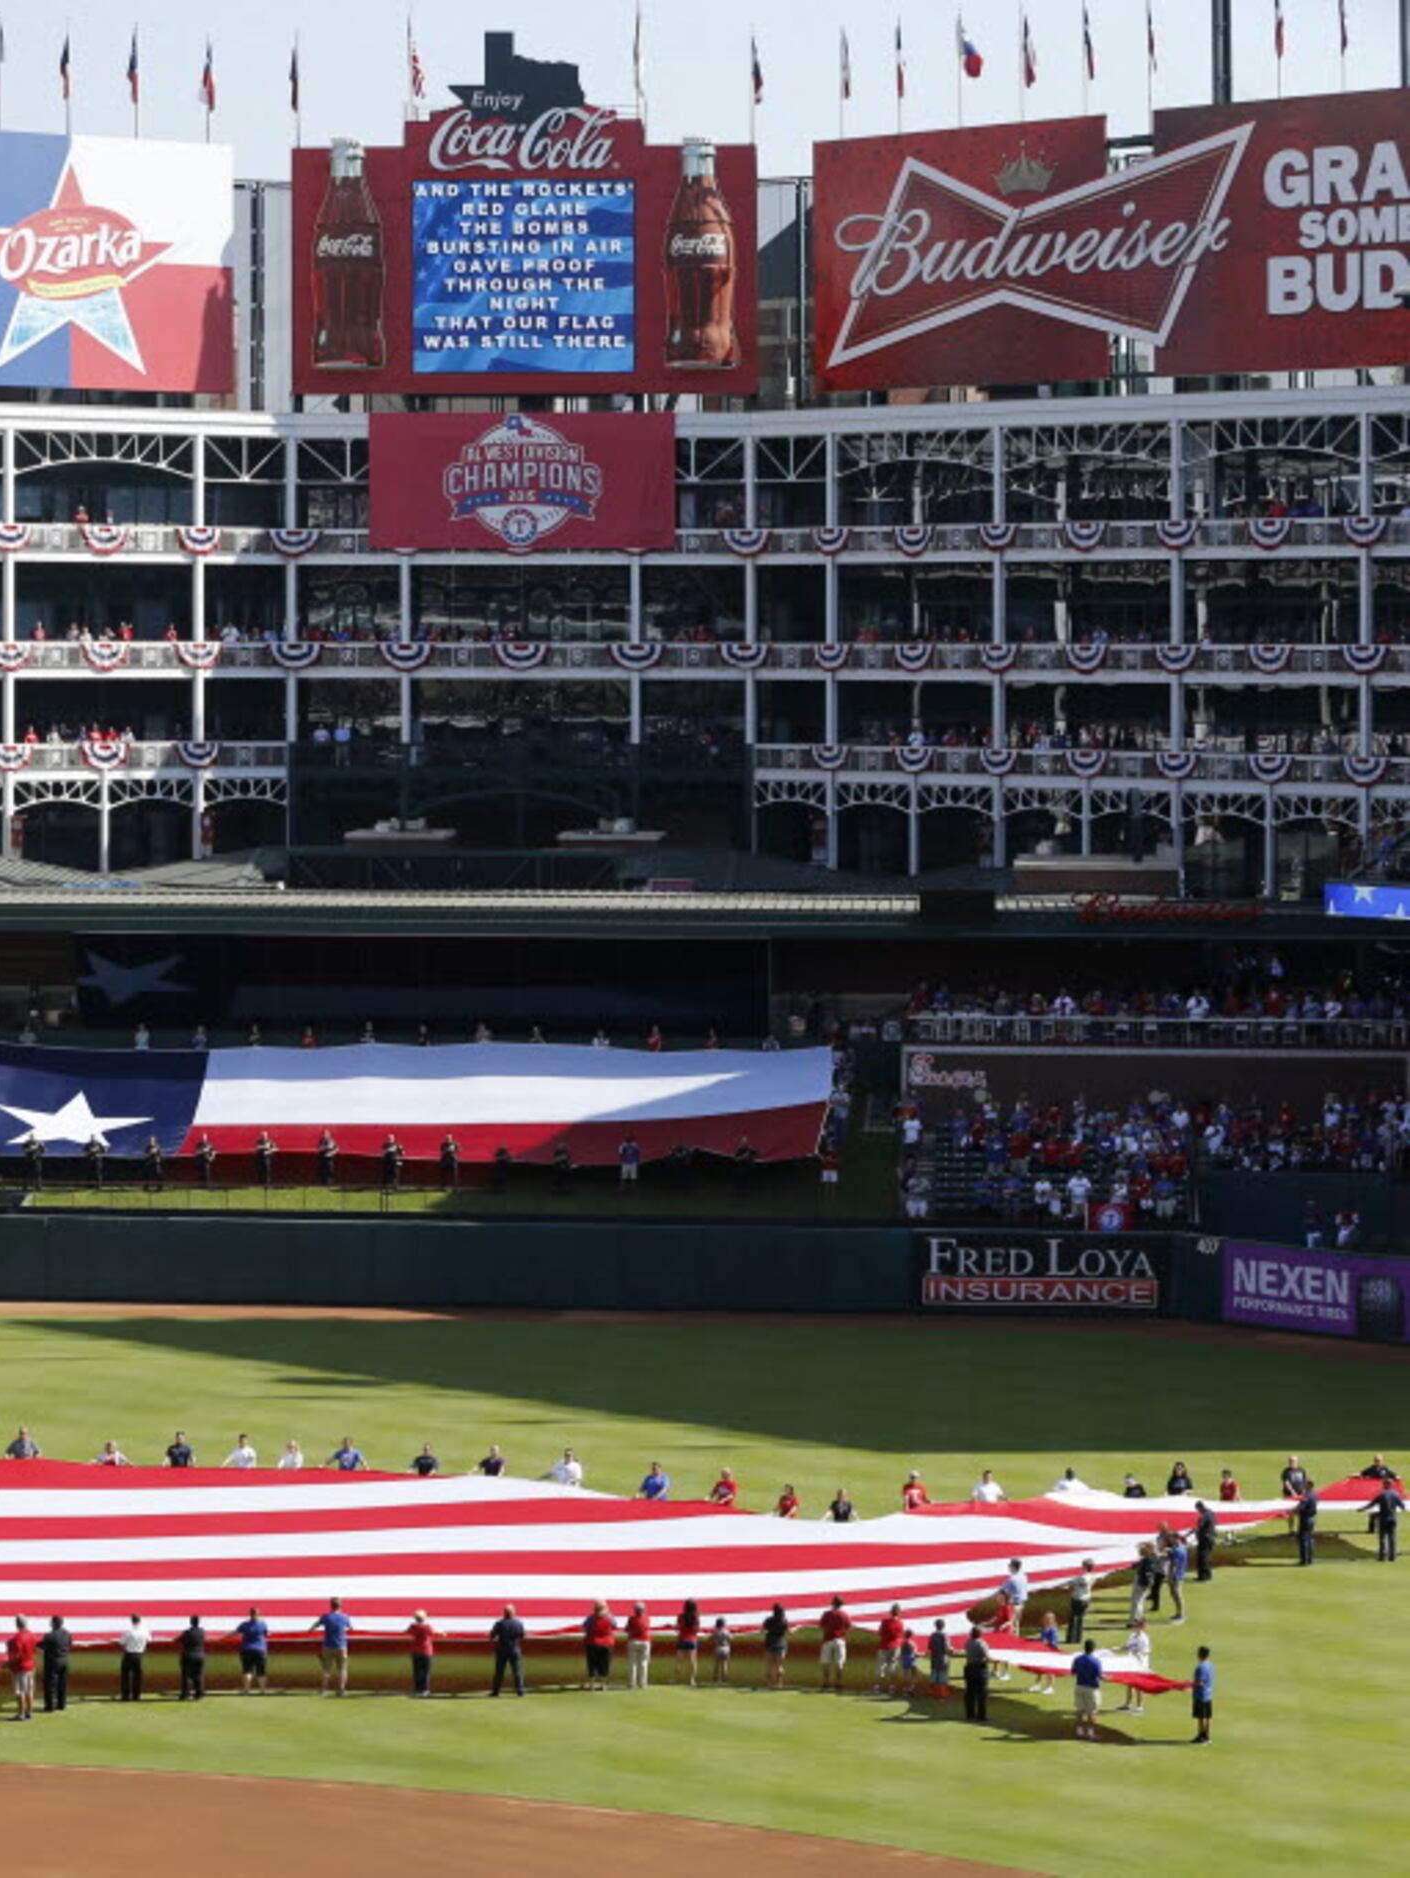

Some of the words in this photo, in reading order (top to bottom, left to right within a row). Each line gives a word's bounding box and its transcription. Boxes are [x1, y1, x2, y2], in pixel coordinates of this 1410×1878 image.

[471, 90, 524, 110] Enjoy
[429, 107, 618, 171] Coca-Cola
[415, 184, 459, 197] AND
[471, 184, 513, 197] THE
[461, 203, 504, 216] RED
[515, 203, 588, 216] GLARE
[460, 221, 502, 235] THE
[513, 221, 589, 235] BOMBS
[0, 223, 142, 281] Ozarka
[426, 240, 542, 254] BURSTING
[552, 240, 574, 254] IN
[586, 240, 623, 254] AIR
[835, 202, 1230, 297] Budweiser
[453, 259, 512, 273] GAVE
[523, 259, 596, 273] PROOF
[445, 278, 552, 292] THROUGH
[563, 278, 605, 292] THE
[490, 296, 560, 310] NIGHT
[435, 316, 492, 329] THAT
[503, 316, 548, 329] OUR
[558, 316, 615, 329] FLAG
[424, 335, 470, 349] WAS
[481, 335, 543, 349] STILL
[553, 335, 626, 349] THERE
[483, 444, 520, 461] WEST
[447, 461, 600, 495] CHAMPIONS
[929, 1236, 1034, 1277] FRED
[1045, 1238, 1155, 1277] LOYA
[1233, 1257, 1351, 1304] NEXEN
[928, 1281, 1153, 1304] INSURANCE
[1233, 1296, 1315, 1317] PERFORMANCE
[1317, 1306, 1350, 1320] TIRES
